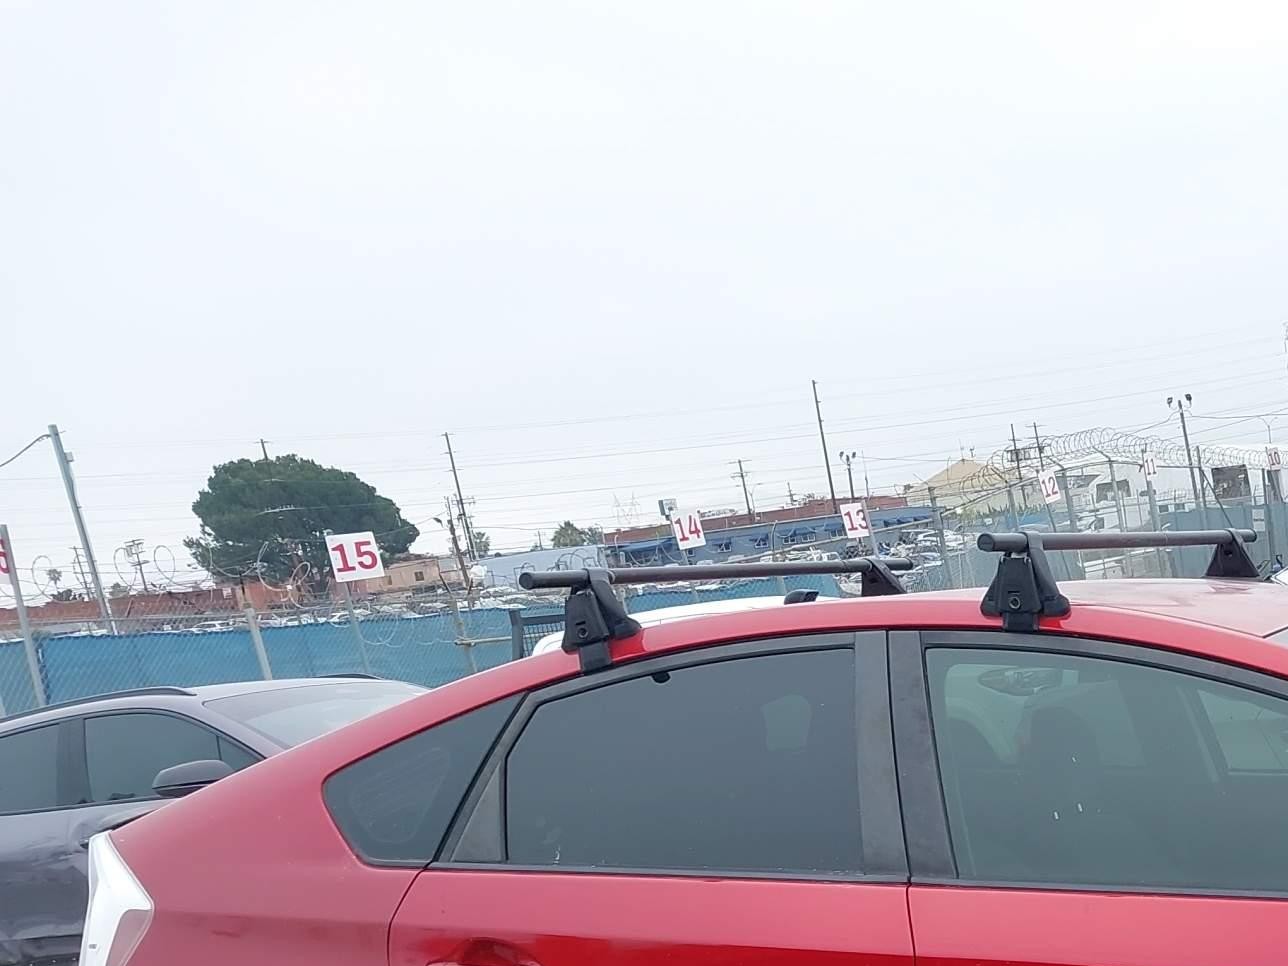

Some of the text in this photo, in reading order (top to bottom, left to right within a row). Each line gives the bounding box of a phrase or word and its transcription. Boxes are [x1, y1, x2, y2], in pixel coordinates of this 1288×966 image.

[1144, 457, 1157, 476] 11
[1268, 451, 1281, 466] 10
[1041, 476, 1059, 498] 12
[674, 514, 701, 542] 14
[843, 508, 869, 531] 13
[331, 540, 378, 573] 15
